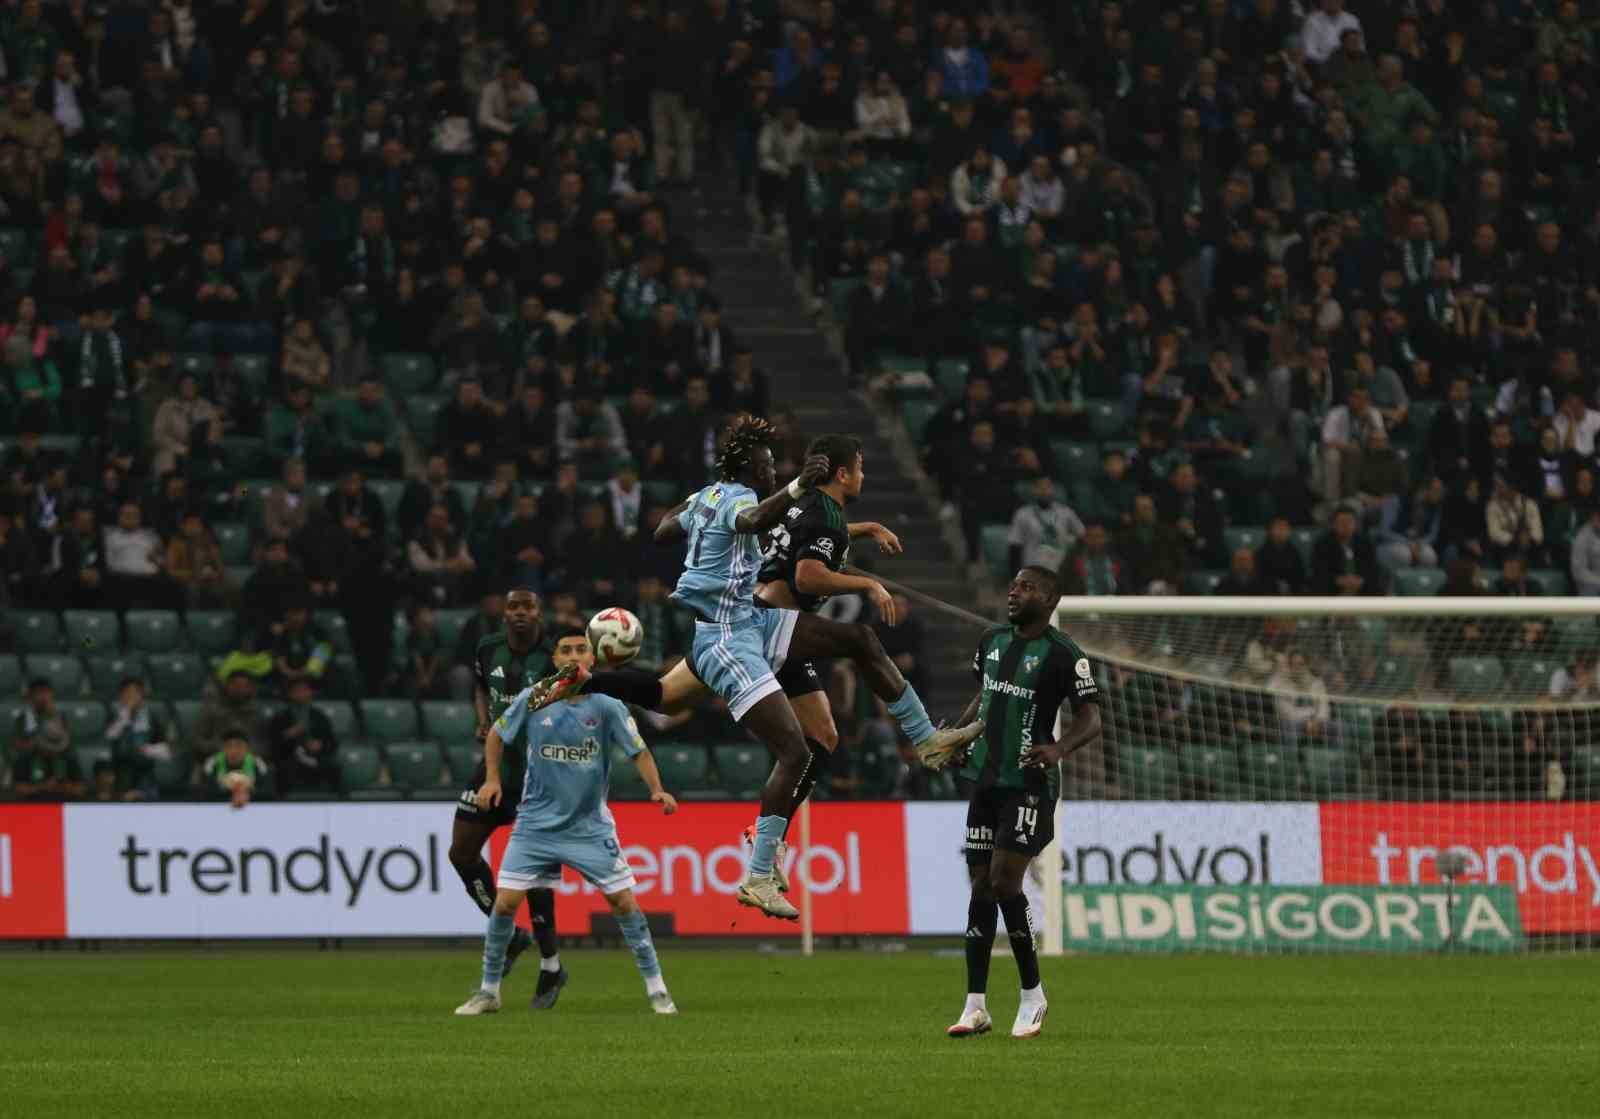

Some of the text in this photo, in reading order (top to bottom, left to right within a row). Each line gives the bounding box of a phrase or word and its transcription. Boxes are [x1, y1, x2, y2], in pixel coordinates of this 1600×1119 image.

[1014, 805, 1038, 836] 14
[603, 837, 619, 857] 9
[120, 834, 440, 907] trendyol
[1066, 893, 1197, 940] HDI
